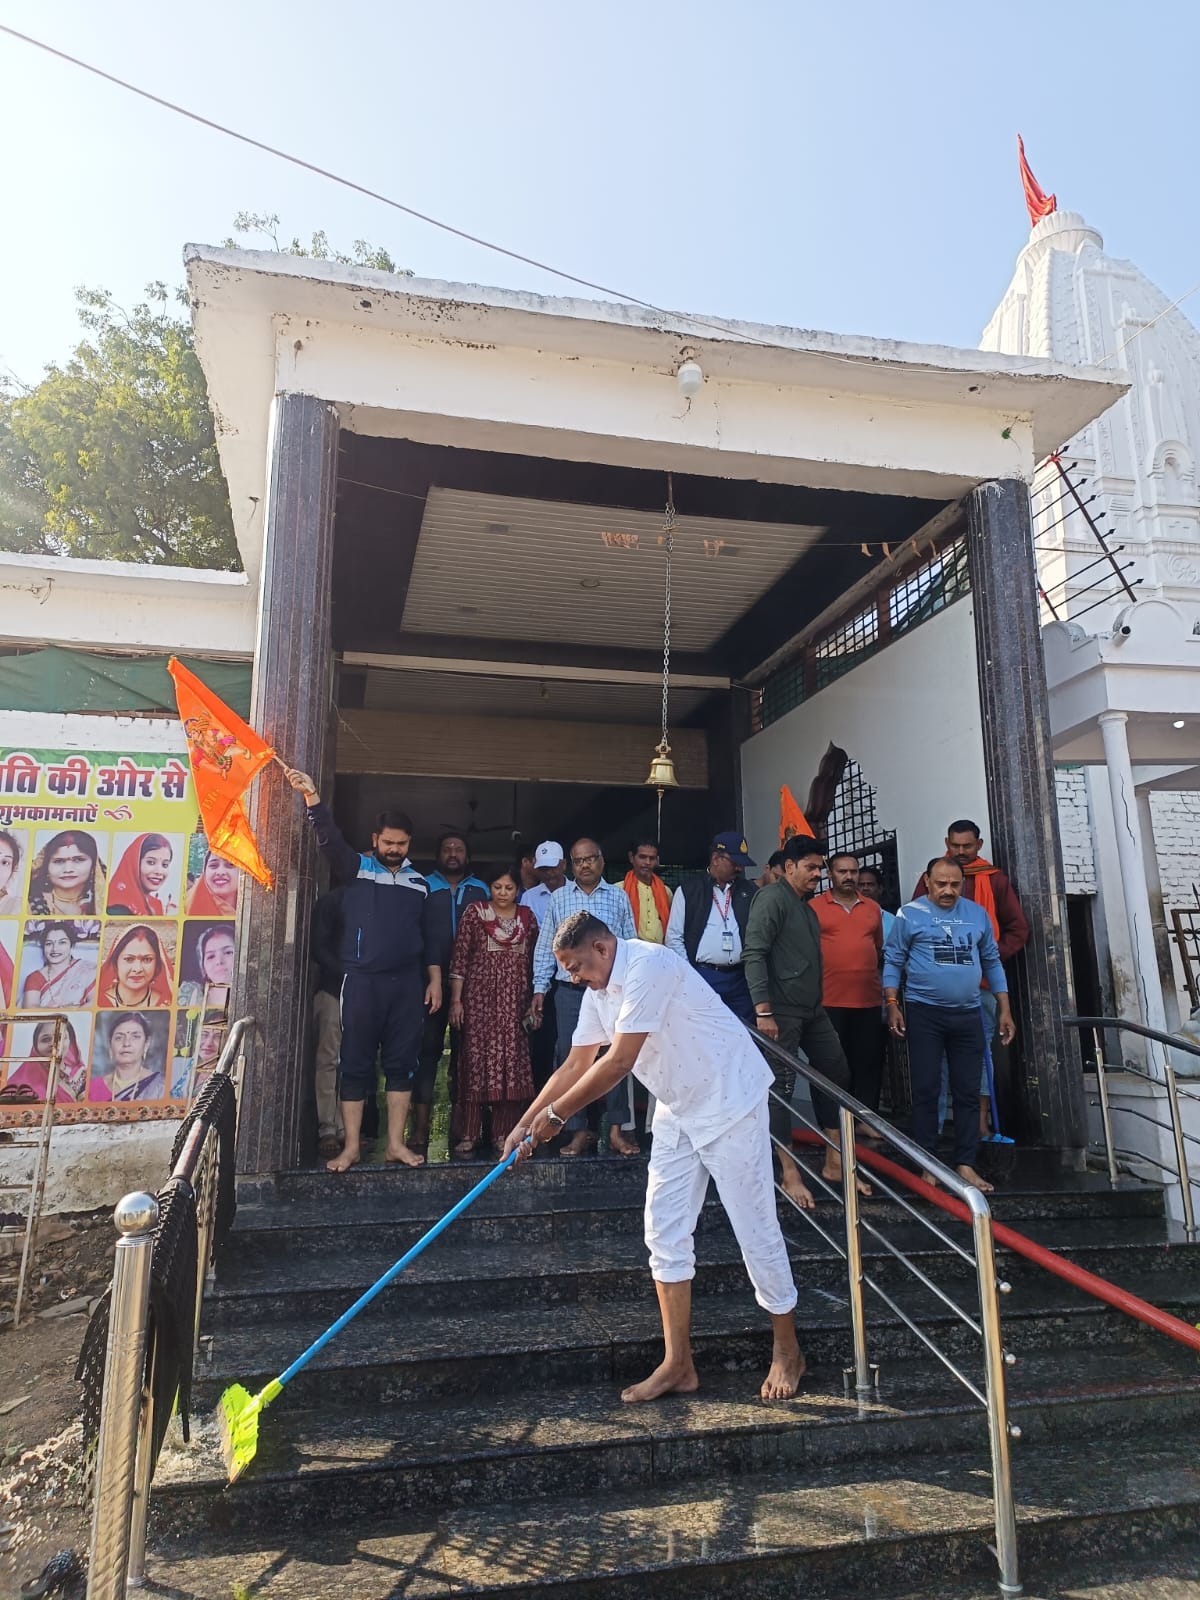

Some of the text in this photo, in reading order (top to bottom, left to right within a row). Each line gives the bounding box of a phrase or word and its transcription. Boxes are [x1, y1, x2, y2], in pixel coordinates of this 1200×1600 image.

[47, 758, 90, 795] की
[97, 760, 155, 797] ओर
[161, 762, 188, 798] से
